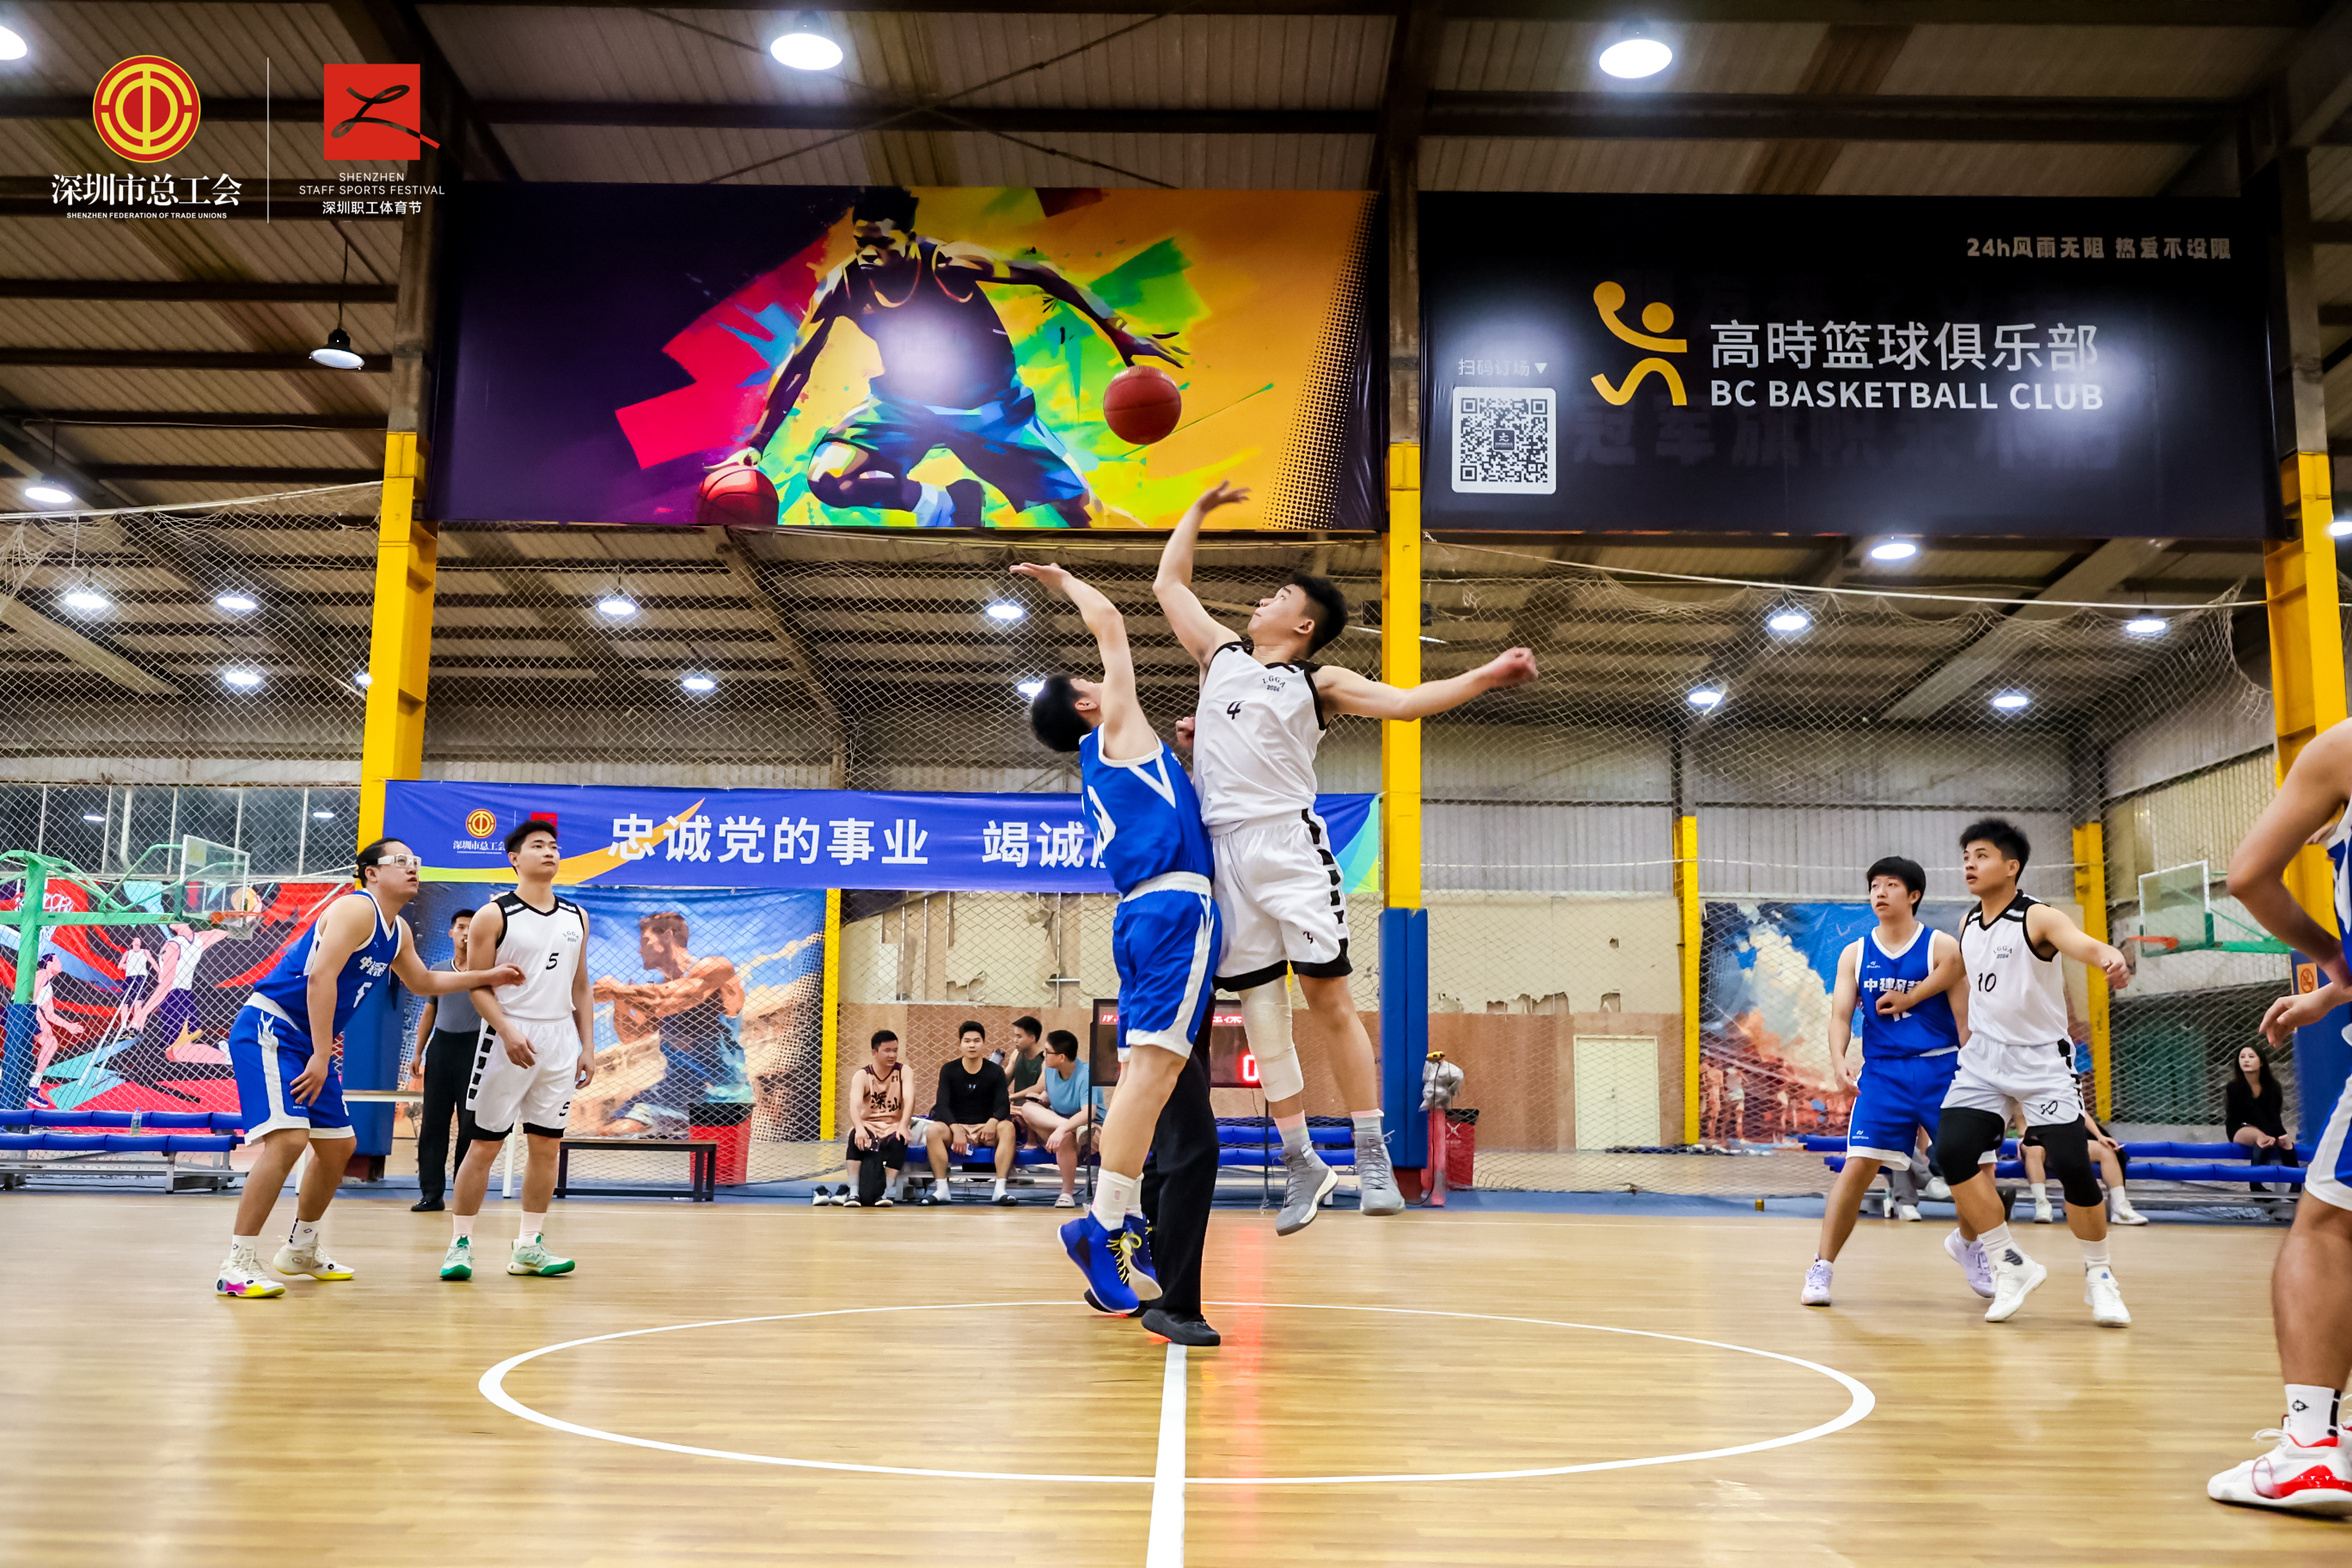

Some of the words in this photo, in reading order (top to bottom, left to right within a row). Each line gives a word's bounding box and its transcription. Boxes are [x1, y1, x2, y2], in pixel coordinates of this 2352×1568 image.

[1967, 236, 2104, 259] 24h风雨无阻
[2116, 236, 2231, 259] 热爱不设限
[1711, 319, 2098, 372] 高時篮球俱乐部
[1458, 358, 1530, 377] 扫码订场
[1712, 379, 1756, 407] BC
[1769, 380, 1998, 409] BASKETBALL
[2010, 382, 2104, 411] CLUB
[1227, 700, 1246, 720] 4
[608, 813, 928, 866] 忠诚党的事业
[545, 952, 560, 971] 5
[1978, 972, 1997, 993] 10
